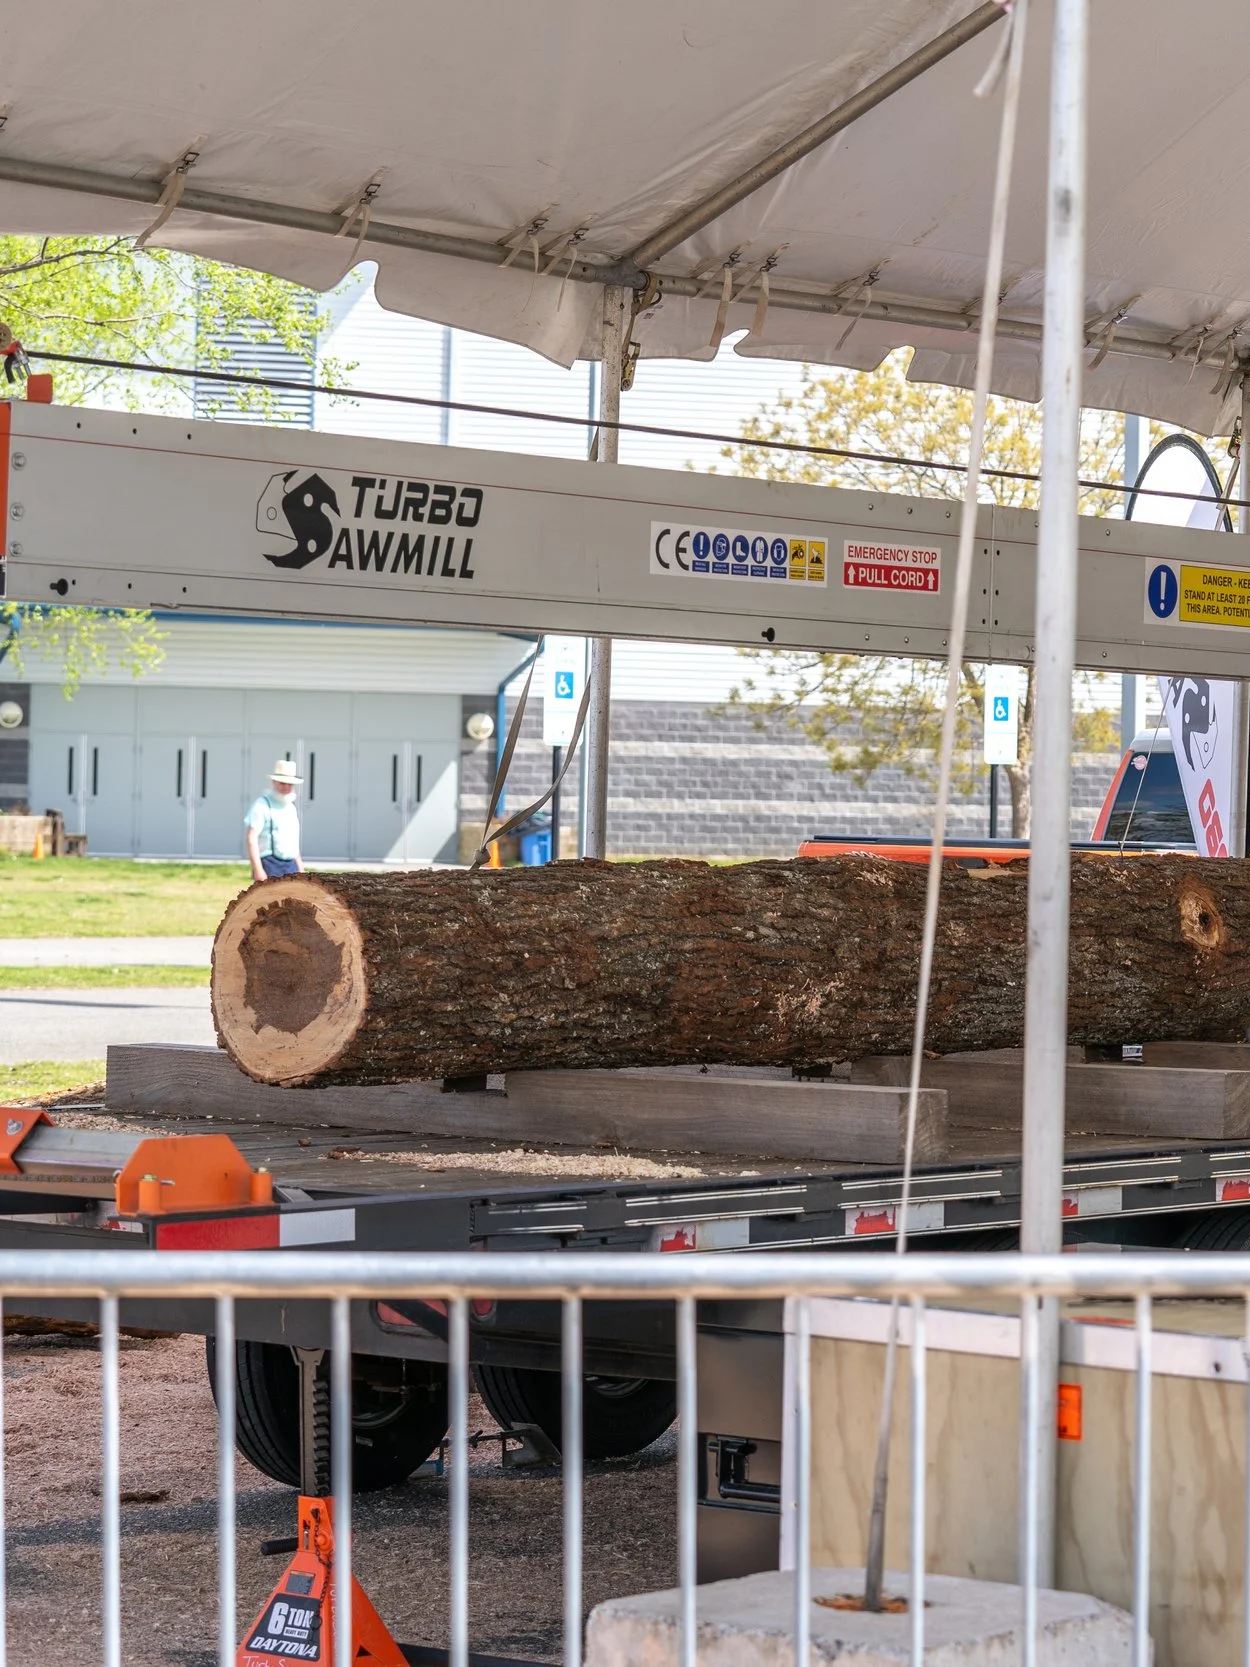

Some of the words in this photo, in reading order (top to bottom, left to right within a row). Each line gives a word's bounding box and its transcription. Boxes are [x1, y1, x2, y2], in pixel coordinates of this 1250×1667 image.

[351, 475, 484, 528] TURBO
[655, 528, 690, 571] CE
[848, 545, 910, 563] EMERGENCY
[911, 550, 938, 564] STOP
[858, 567, 888, 585] PULL
[890, 569, 925, 587] CORD
[1202, 574, 1233, 588] DANGER
[1184, 589, 1206, 601] STAND
[1206, 591, 1216, 602] AT
[1216, 592, 1237, 604] LEAST
[1237, 595, 1246, 605] 20
[1186, 602, 1201, 614] THIS
[267, 1602, 290, 1635] 6
[287, 1607, 315, 1628] TON
[249, 1636, 318, 1658] DAYTONA
